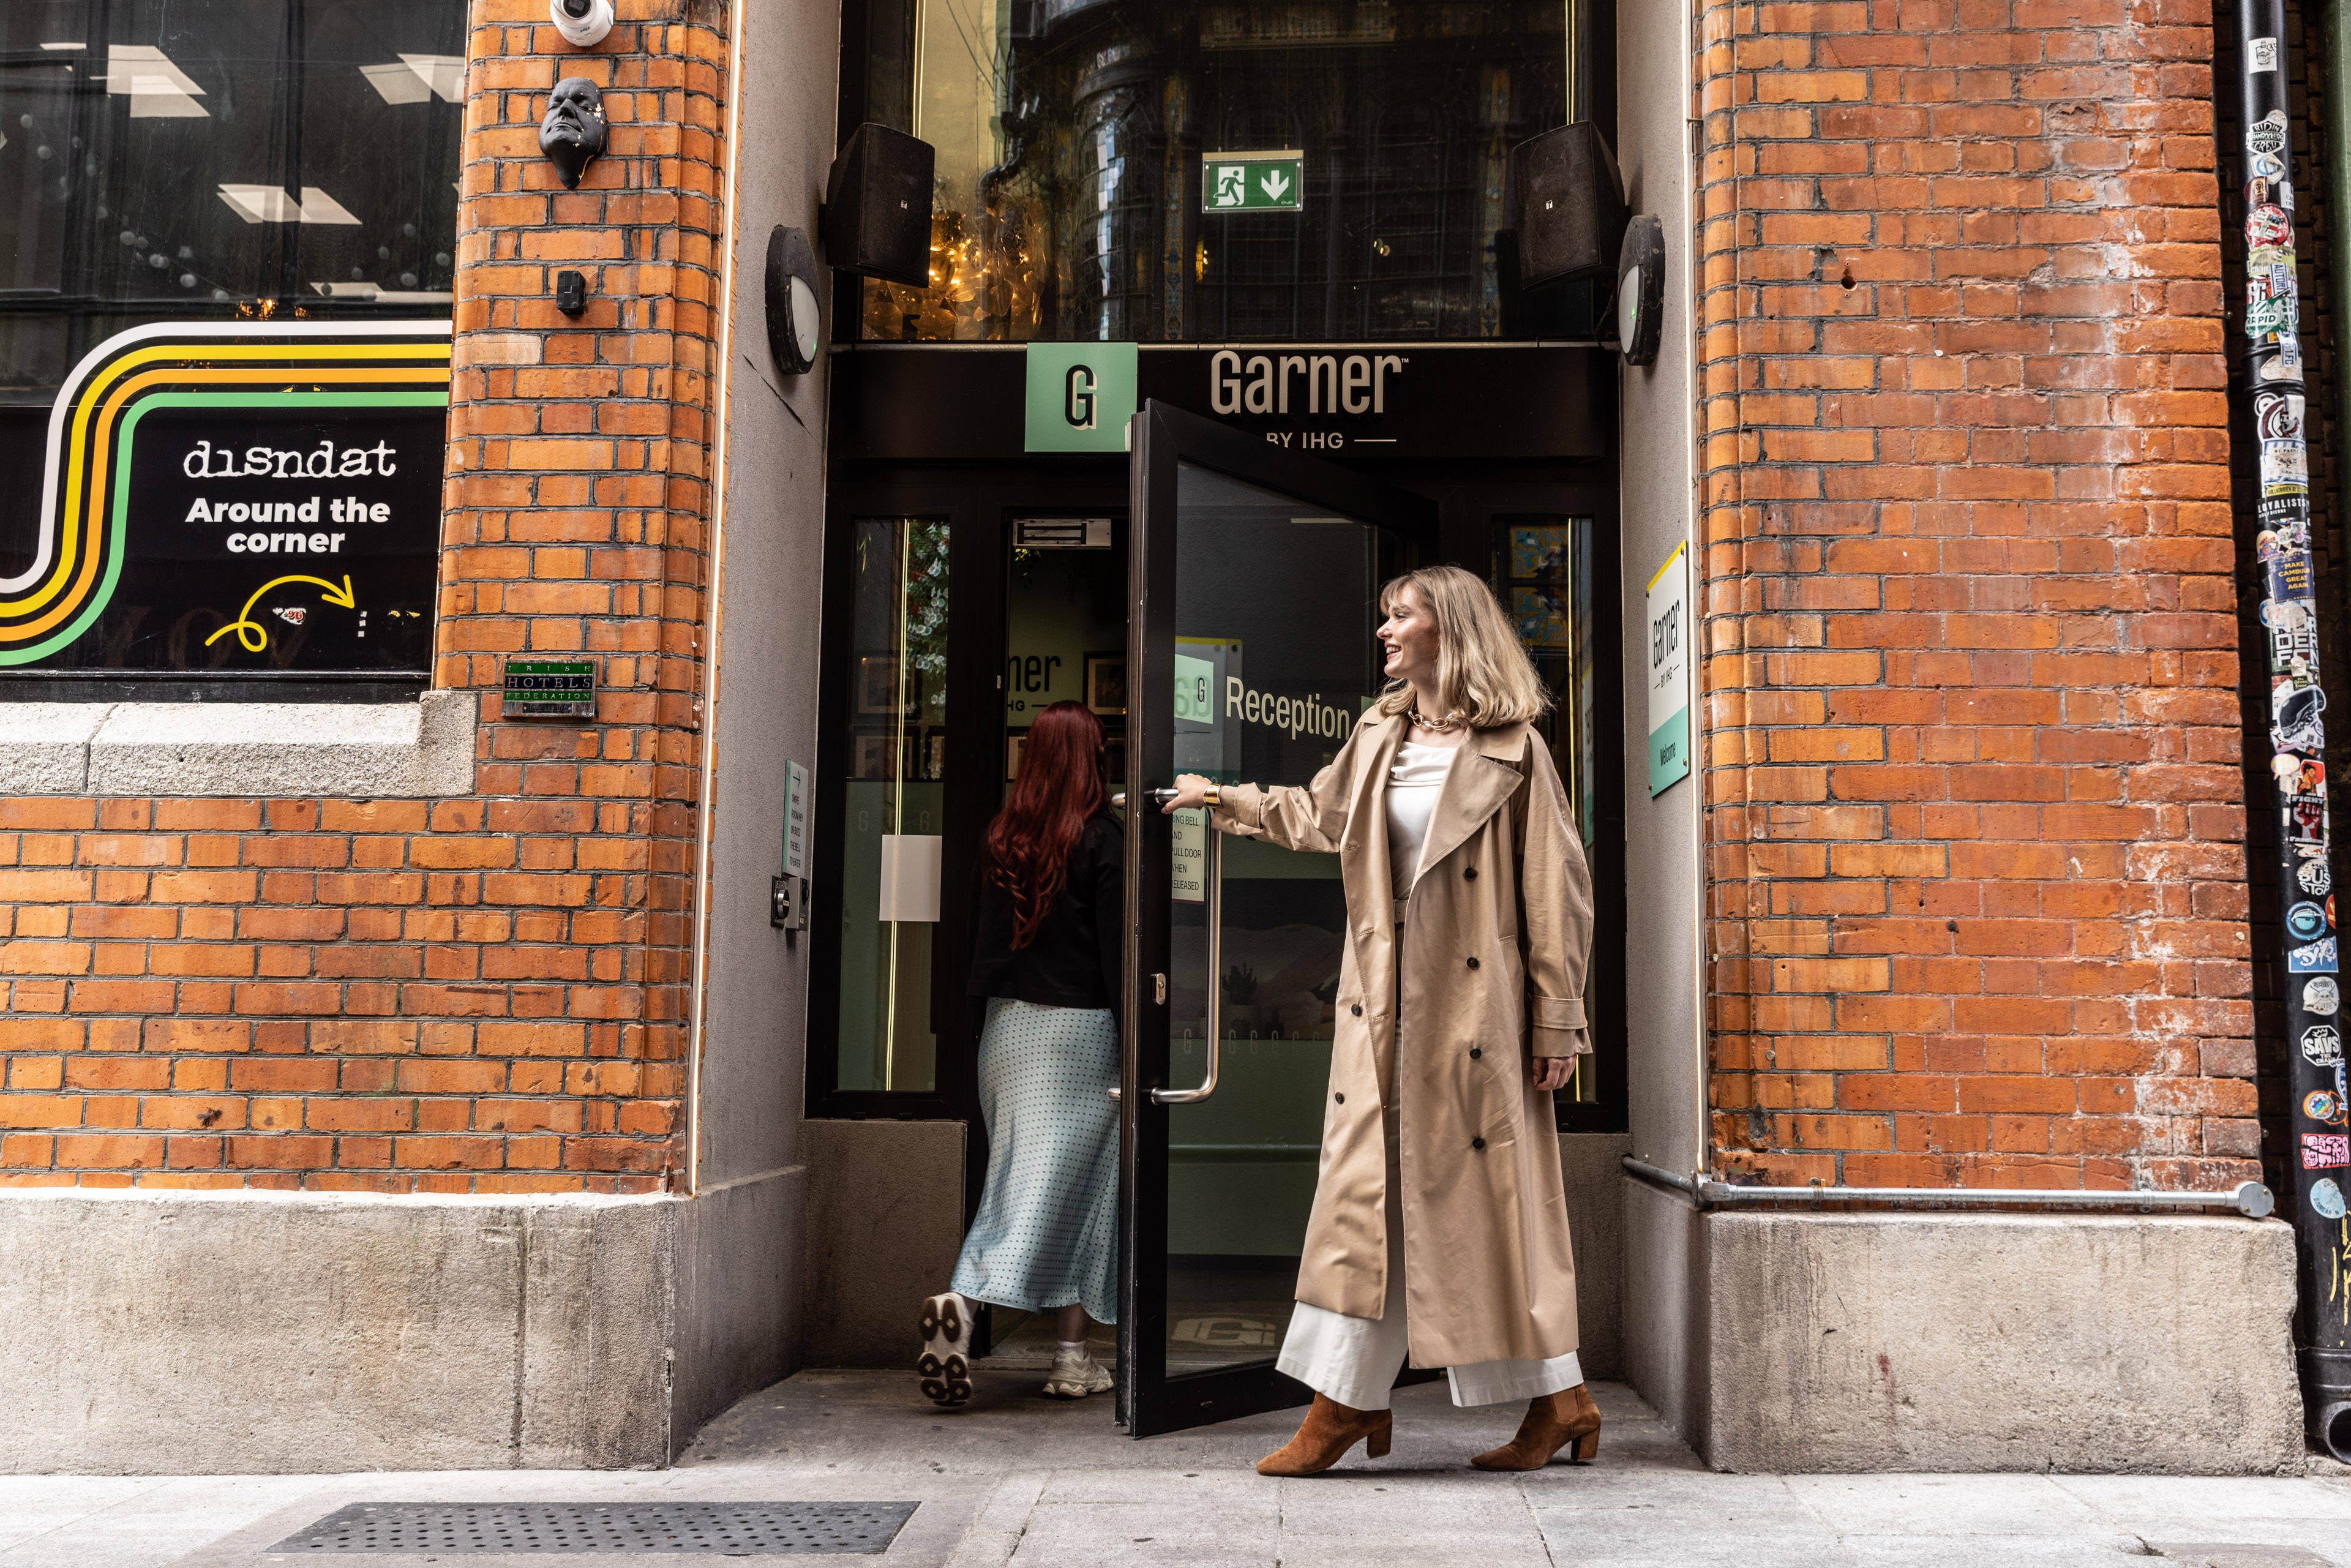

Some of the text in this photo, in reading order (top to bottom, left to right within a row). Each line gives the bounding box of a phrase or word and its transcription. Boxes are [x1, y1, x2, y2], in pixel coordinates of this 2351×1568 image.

[1211, 350, 1402, 414] Garner
[1065, 364, 1097, 430] G
[1302, 432, 1343, 449] IHG
[185, 497, 391, 523] Around the
[2258, 498, 2306, 513] LOYALISTS
[227, 533, 345, 553] corner
[1653, 599, 1680, 670] Garner
[507, 677, 591, 688] HOTELS
[1226, 675, 1349, 740] Reception
[1660, 742, 1676, 767] Welcome
[1185, 816, 1199, 827] BELL
[1172, 831, 1182, 840] ND
[1185, 848, 1201, 858] DOOR
[2299, 881, 2330, 896] STOP
